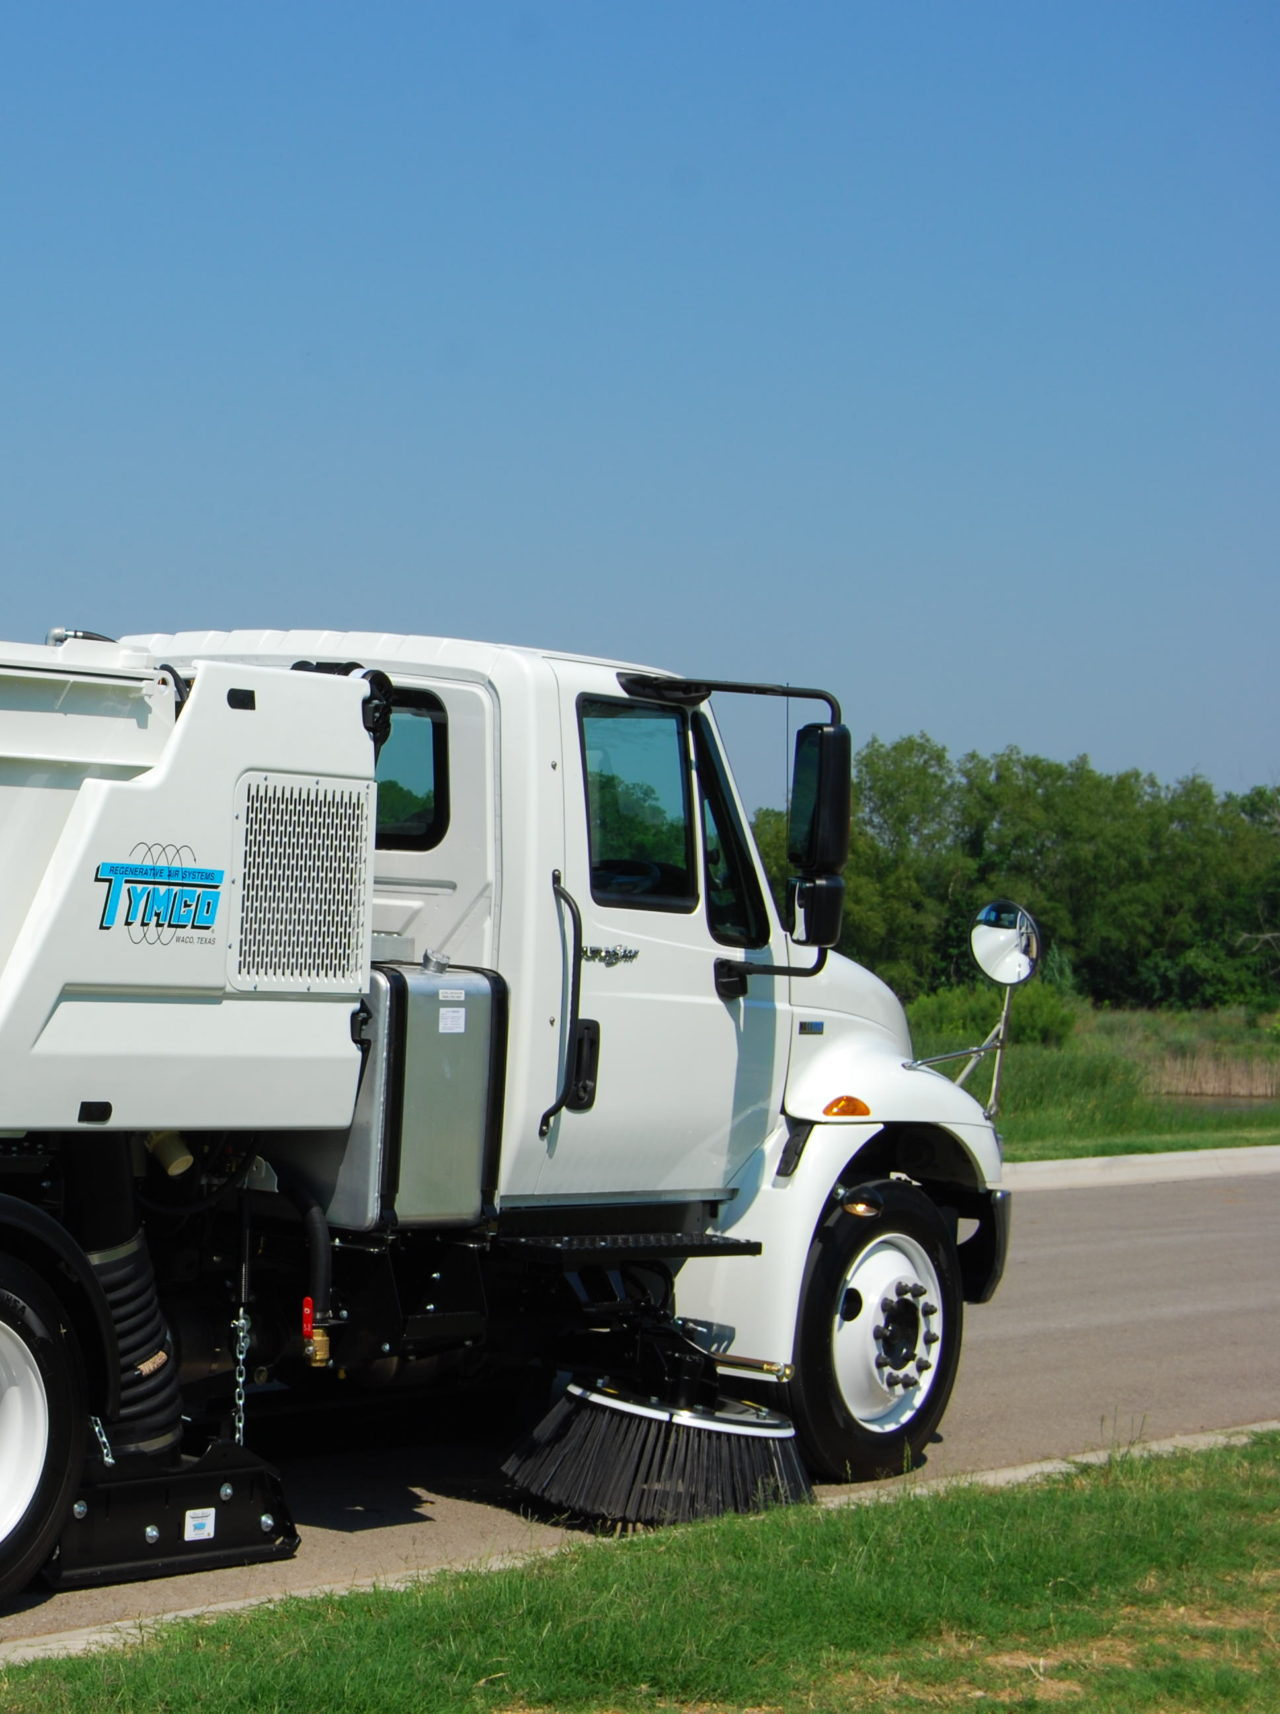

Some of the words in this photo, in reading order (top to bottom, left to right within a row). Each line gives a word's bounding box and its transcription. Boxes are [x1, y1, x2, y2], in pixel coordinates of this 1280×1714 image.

[109, 865, 164, 878] REGENERATIVE
[168, 869, 180, 878] AIR
[182, 869, 216, 882] SYSTEMS
[94, 862, 225, 930] TYMCO
[197, 937, 216, 945] TEXAS
